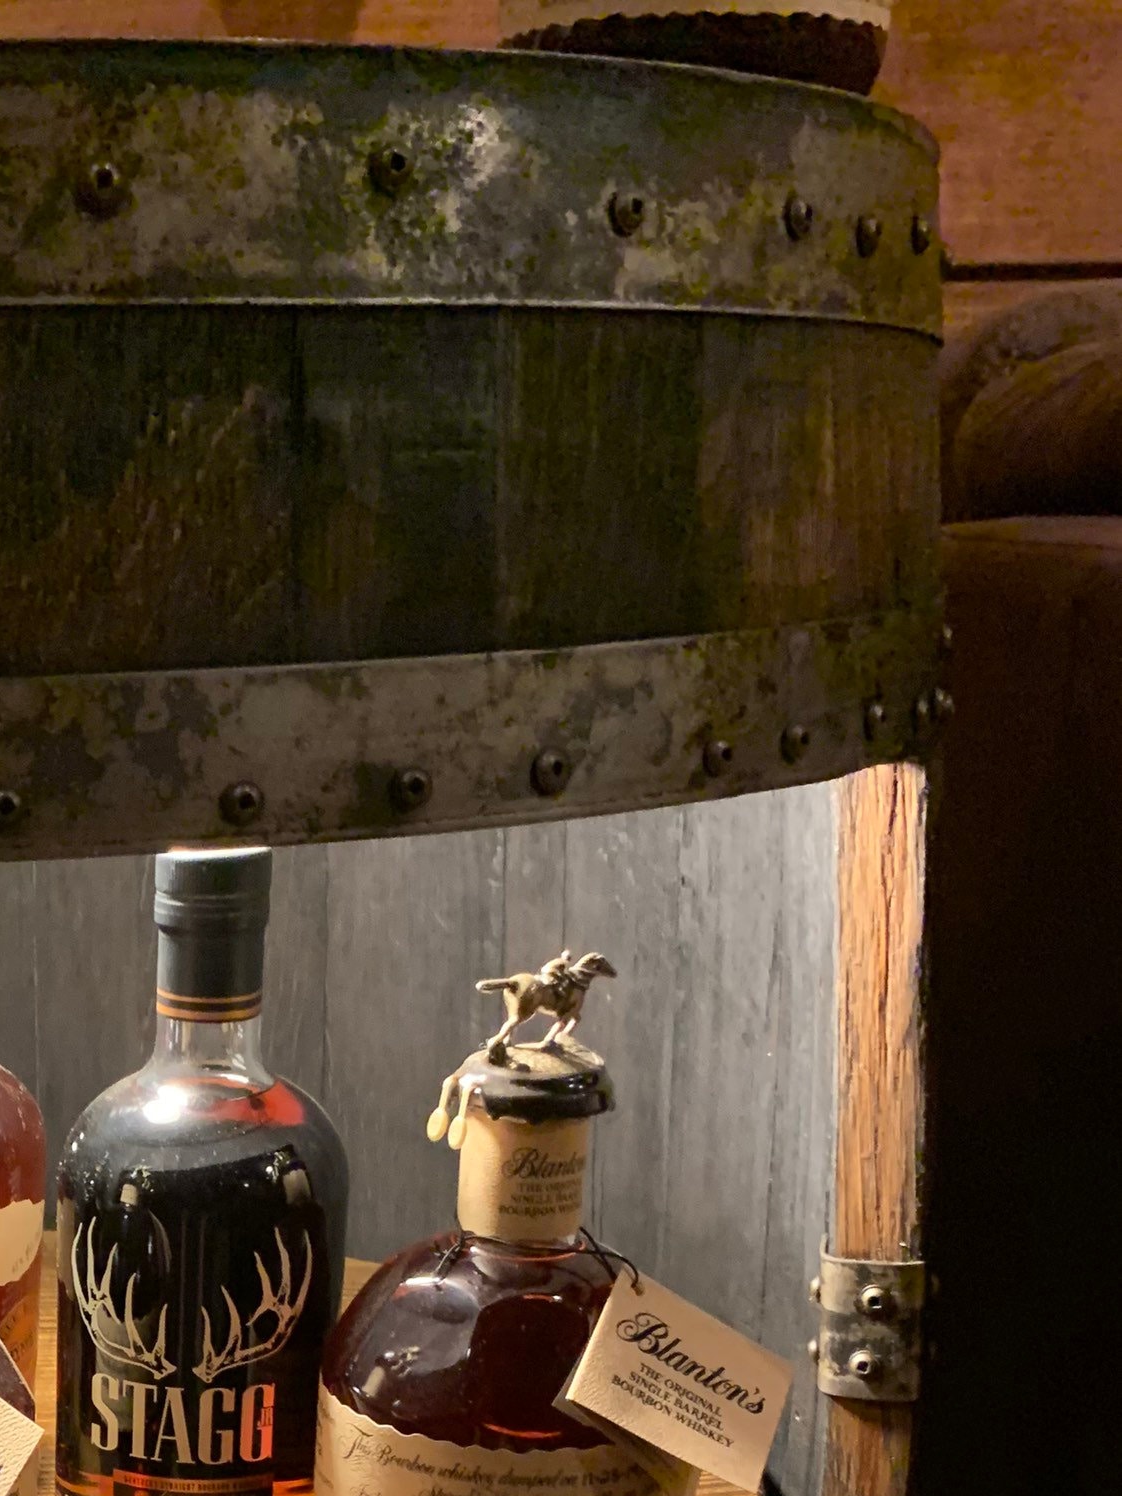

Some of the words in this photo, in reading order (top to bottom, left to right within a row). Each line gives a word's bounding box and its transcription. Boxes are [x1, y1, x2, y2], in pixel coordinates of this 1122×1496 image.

[615, 1312, 766, 1415] Blanton's
[640, 1363, 663, 1381] THE
[664, 1379, 722, 1417] ORIGINAL
[89, 1372, 276, 1466] STAGG
[611, 1374, 672, 1416] BOURBON
[674, 1412, 734, 1448] WHISKEY
[629, 1371, 672, 1403] SINGLE
[673, 1397, 724, 1431] BARREL
